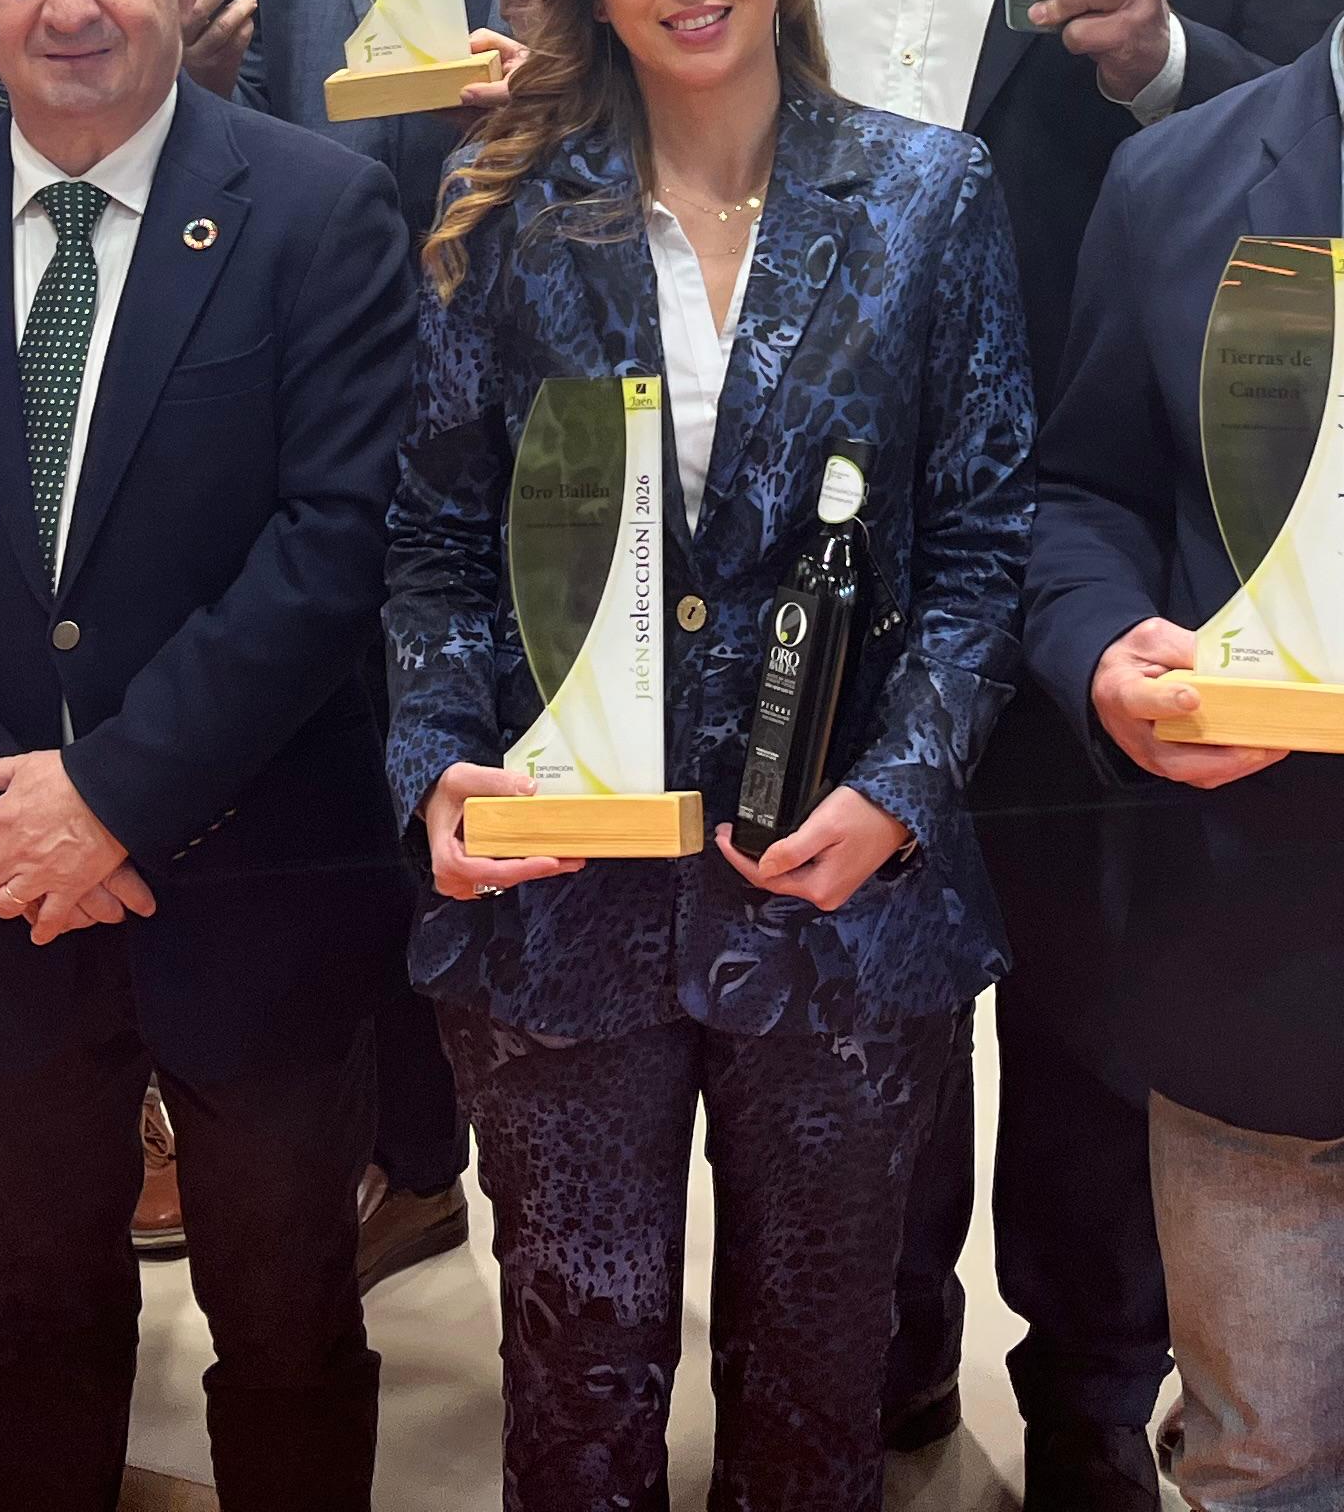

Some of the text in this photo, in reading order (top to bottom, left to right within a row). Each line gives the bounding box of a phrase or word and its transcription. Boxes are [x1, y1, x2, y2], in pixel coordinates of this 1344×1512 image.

[1220, 348, 1312, 366] Tierras de
[521, 484, 552, 499] Oro
[636, 474, 650, 515] 2026
[770, 646, 801, 668] ORO
